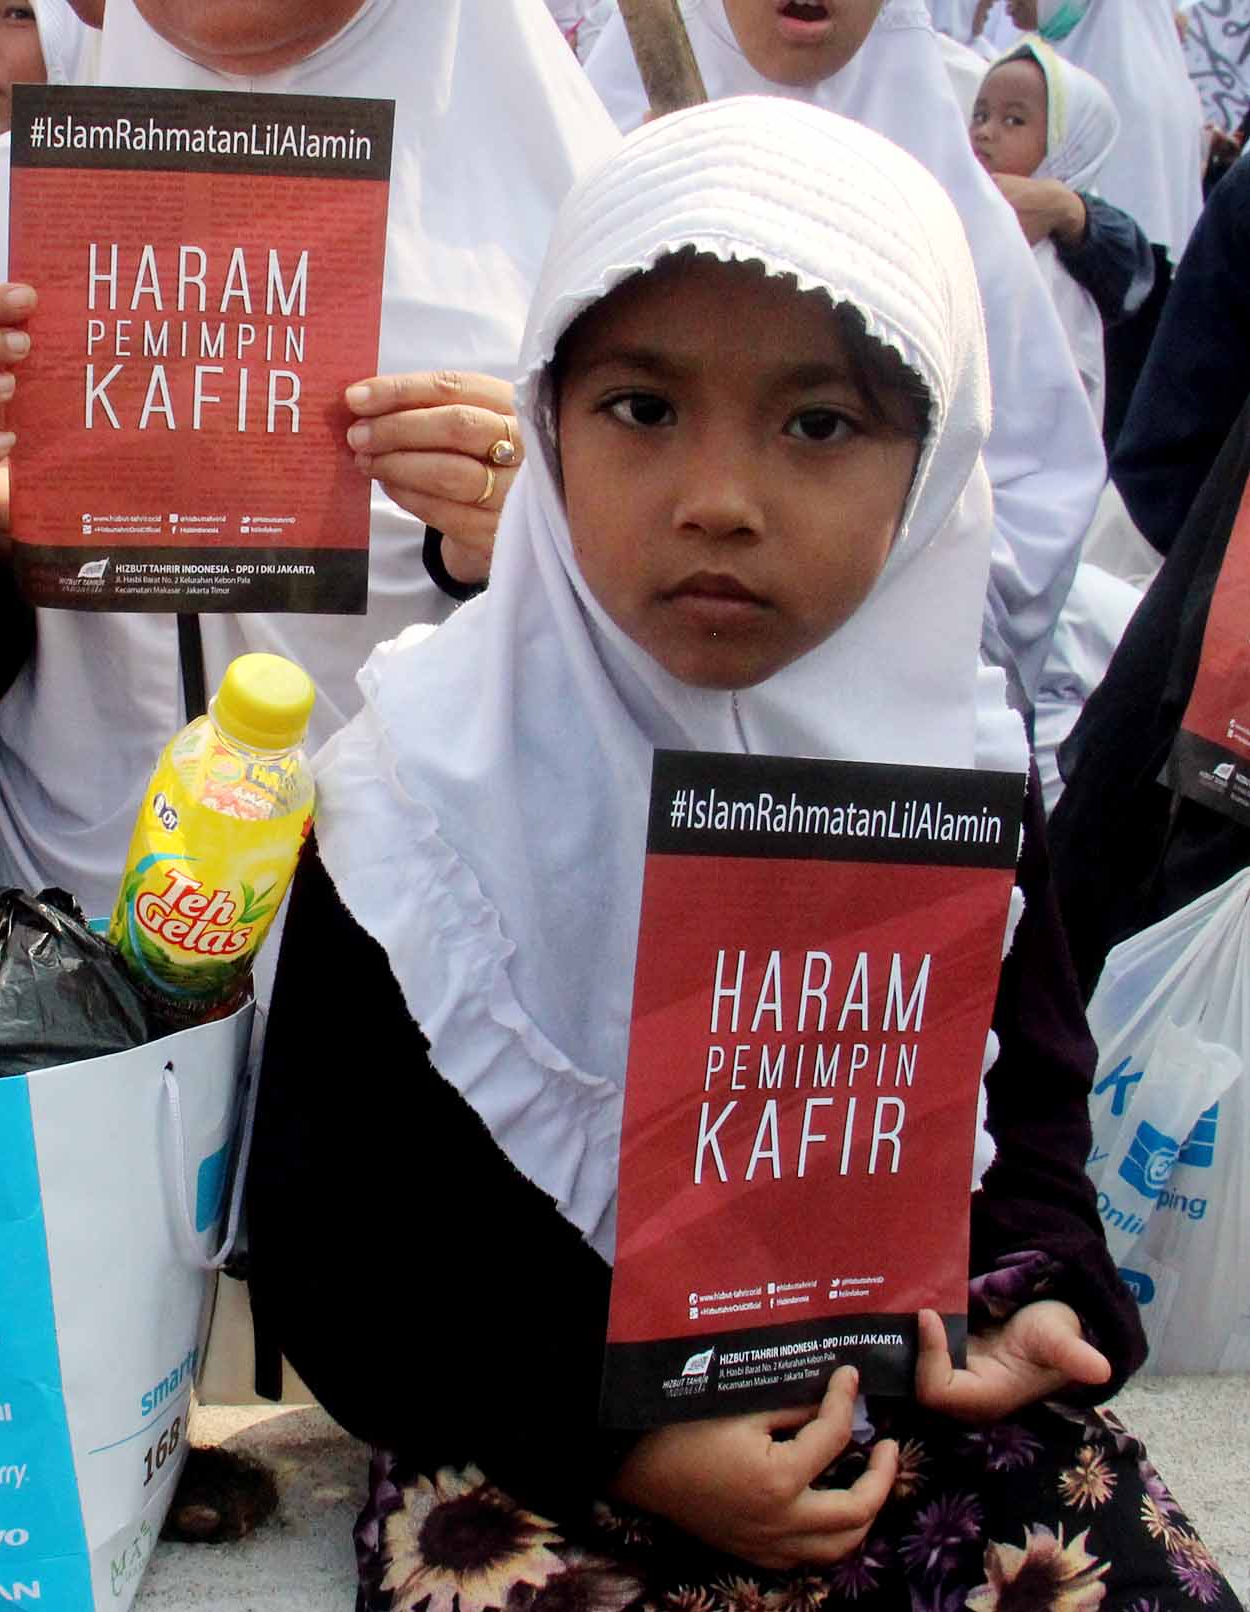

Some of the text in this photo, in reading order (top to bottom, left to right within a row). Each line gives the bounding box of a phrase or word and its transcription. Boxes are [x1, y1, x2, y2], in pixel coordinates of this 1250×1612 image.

[30, 116, 372, 160] #IslamRahmatanLilAlamin
[88, 243, 309, 317] HARAM
[87, 319, 305, 363] PEMIMPIN
[85, 363, 302, 433] KAFIR
[116, 564, 148, 574] HIZBUT
[149, 565, 180, 574] TAHRIR
[182, 565, 229, 574] INDONESIA
[236, 565, 254, 574] DPD
[261, 565, 275, 574] DKI
[277, 565, 315, 574] JAKARTA
[670, 789, 1002, 844] #IslamRahmatanLilAlamin
[136, 892, 253, 956] Gelas
[161, 867, 236, 926] Teh
[710, 950, 932, 1033] HARAM
[704, 1043, 918, 1092] PEMIMPIN
[693, 1096, 906, 1184] KAFIR
[1097, 1191, 1146, 1236] Onli
[1156, 1187, 1207, 1221] ping
[719, 1351, 749, 1365] HIZBUT
[751, 1348, 779, 1361] TAHRIR
[780, 1341, 819, 1357] INDONESIA
[823, 1337, 838, 1349] DPD
[843, 1335, 858, 1346] DKI
[859, 1334, 903, 1345] JAKARTA
[143, 1416, 181, 1487] 168
